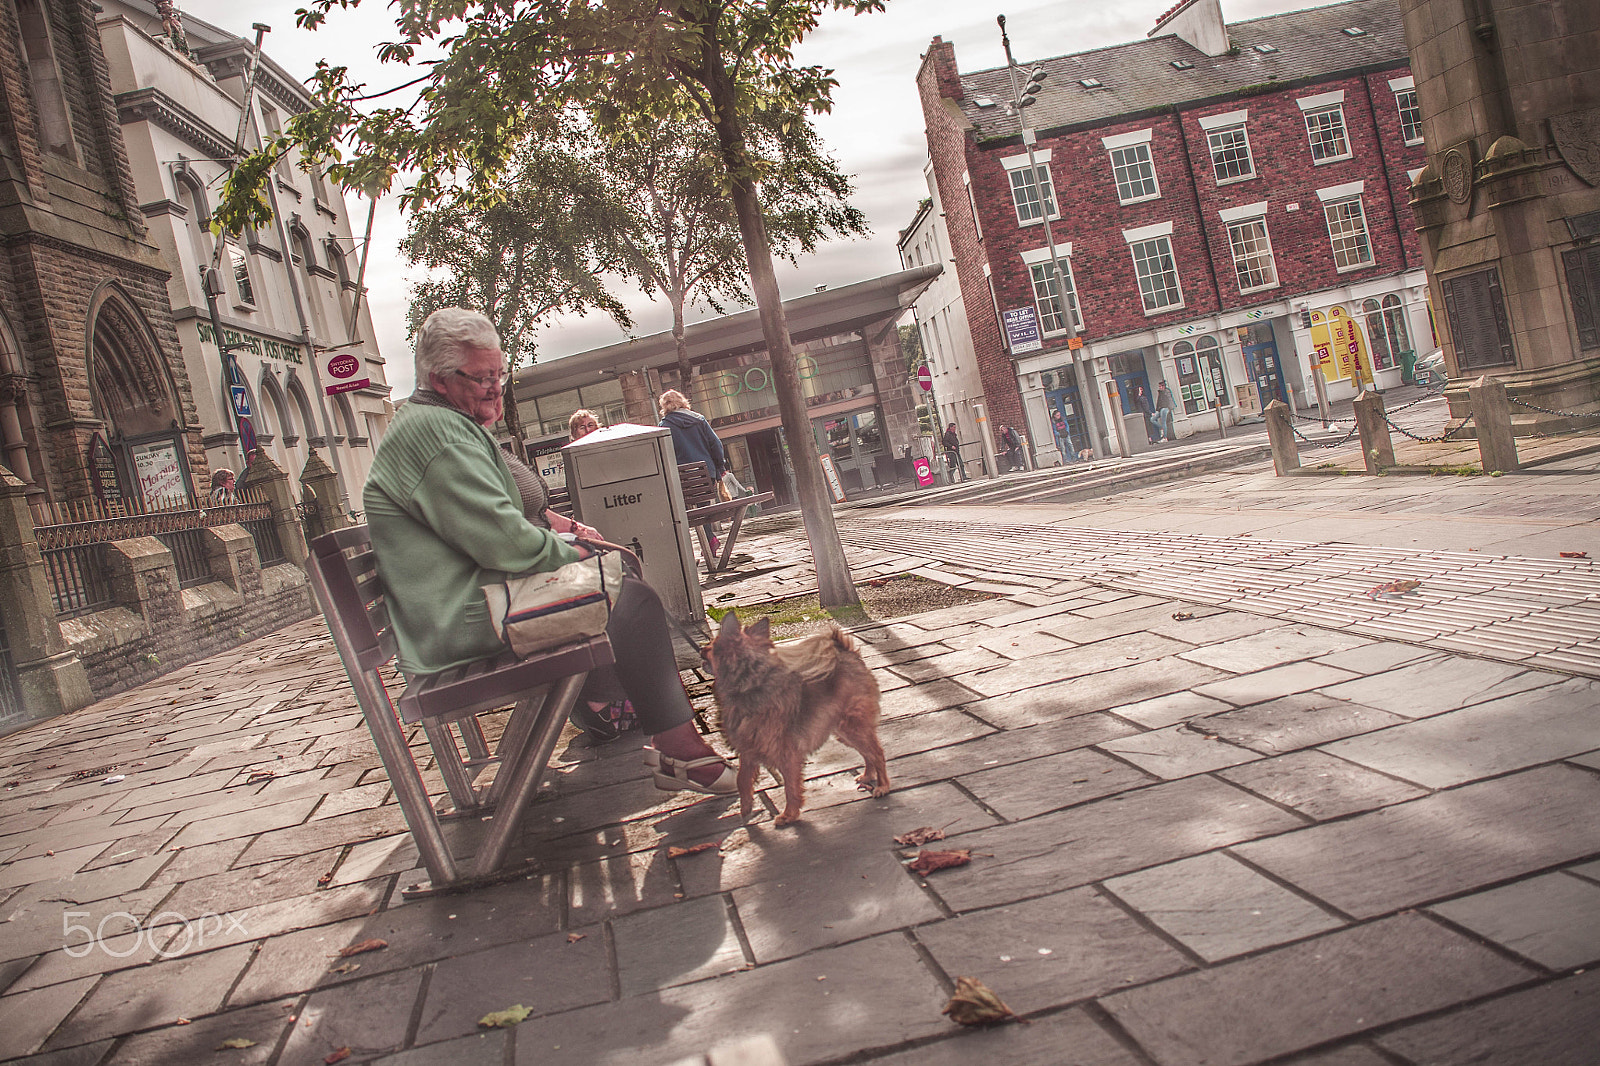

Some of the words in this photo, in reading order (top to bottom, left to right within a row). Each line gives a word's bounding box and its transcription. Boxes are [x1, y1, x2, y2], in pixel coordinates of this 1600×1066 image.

[1548, 174, 1570, 188] 1914
[1018, 313, 1034, 321] OFFICE
[1012, 330, 1035, 338] WILD
[263, 339, 281, 360] POST
[280, 343, 303, 365] OFFICE
[332, 362, 354, 375] POST
[136, 452, 160, 462] SUNDAY
[137, 460, 153, 468] 10.30
[141, 460, 180, 491] Morning
[542, 466, 558, 476] BT
[145, 475, 181, 505] Service
[603, 493, 643, 509] Litter
